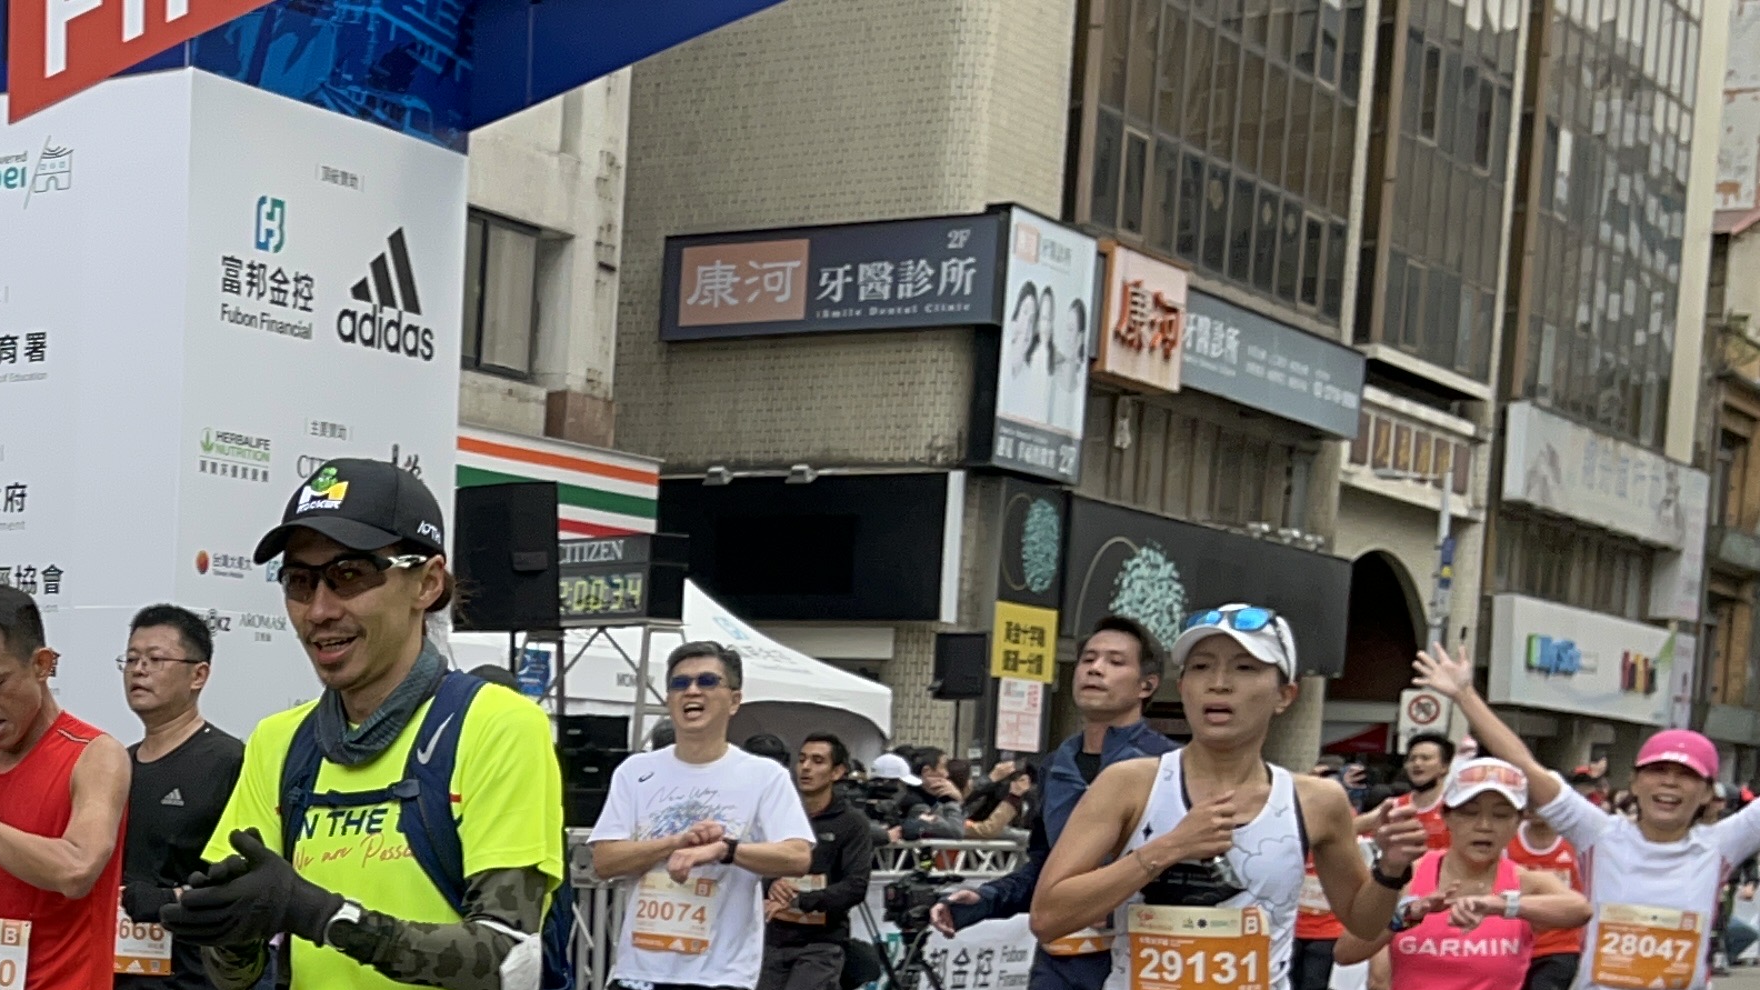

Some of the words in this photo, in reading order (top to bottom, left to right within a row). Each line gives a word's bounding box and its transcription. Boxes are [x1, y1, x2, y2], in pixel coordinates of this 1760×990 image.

[946, 227, 971, 250] 2F
[221, 255, 314, 313] 富邦金控
[687, 259, 801, 308] 康河
[816, 256, 977, 303] 牙醫診所
[220, 303, 258, 330] Fubon
[259, 312, 313, 340] Financial
[337, 304, 434, 362] adidas
[1113, 279, 1181, 361] 康河
[214, 444, 271, 463] NUTRITION
[215, 430, 271, 451] HERBALIFE
[328, 807, 390, 838] THE
[636, 899, 707, 924] 20074
[3, 926, 18, 945] B
[1399, 935, 1520, 958] GARMIN
[1600, 931, 1694, 962] 28047
[1138, 947, 1260, 985] 29131
